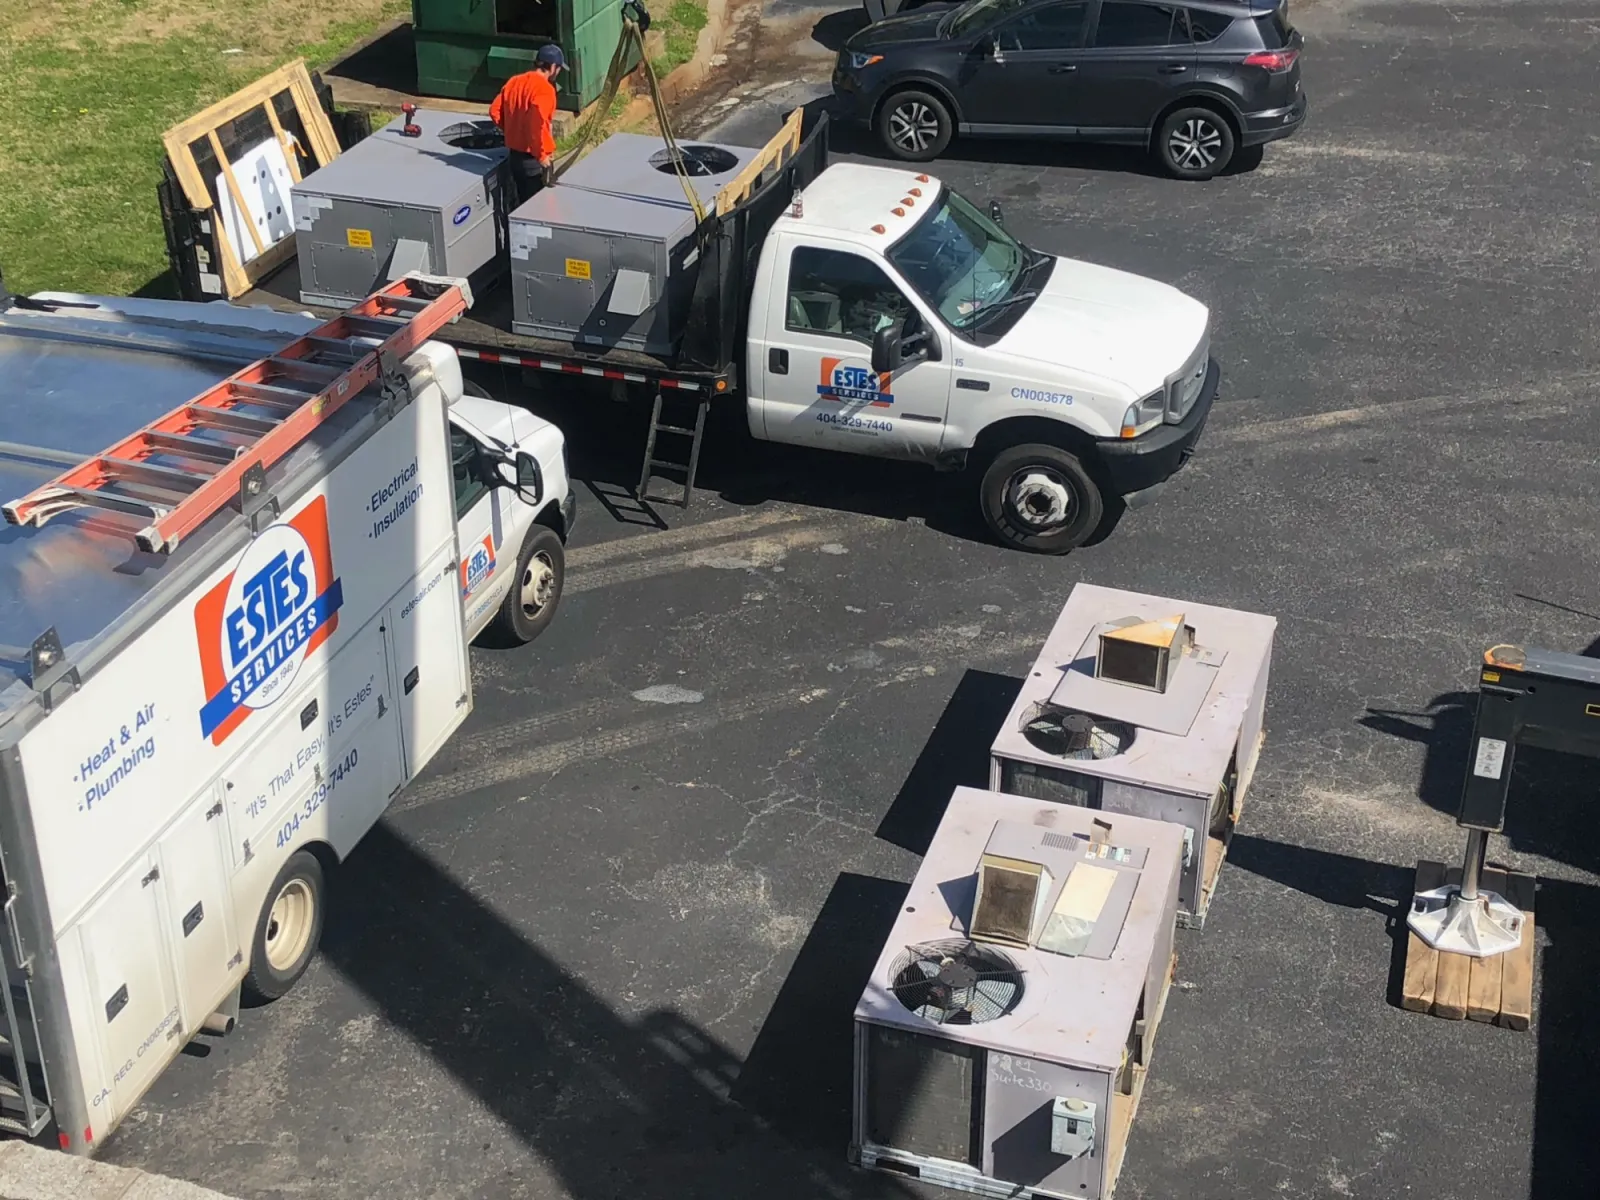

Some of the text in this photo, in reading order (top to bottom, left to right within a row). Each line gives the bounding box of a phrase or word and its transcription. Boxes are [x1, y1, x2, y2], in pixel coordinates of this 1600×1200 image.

[834, 366, 876, 390] ESTES
[954, 357, 964, 368] 15
[816, 412, 893, 432] 404-329-7440
[831, 388, 879, 401] SERVICES
[1010, 386, 1074, 406] CN003678
[371, 456, 419, 512] Electrical
[373, 482, 424, 539] Insulation
[467, 549, 488, 582] ESTES
[226, 549, 308, 669] ESTES
[400, 572, 442, 619] estesair.com
[231, 607, 318, 704] SERVICES
[80, 702, 155, 782] Heat & Air
[268, 763, 295, 797] That
[327, 714, 342, 738] It's
[85, 736, 155, 811] Plumbing
[276, 748, 358, 849] 404-329-7440
